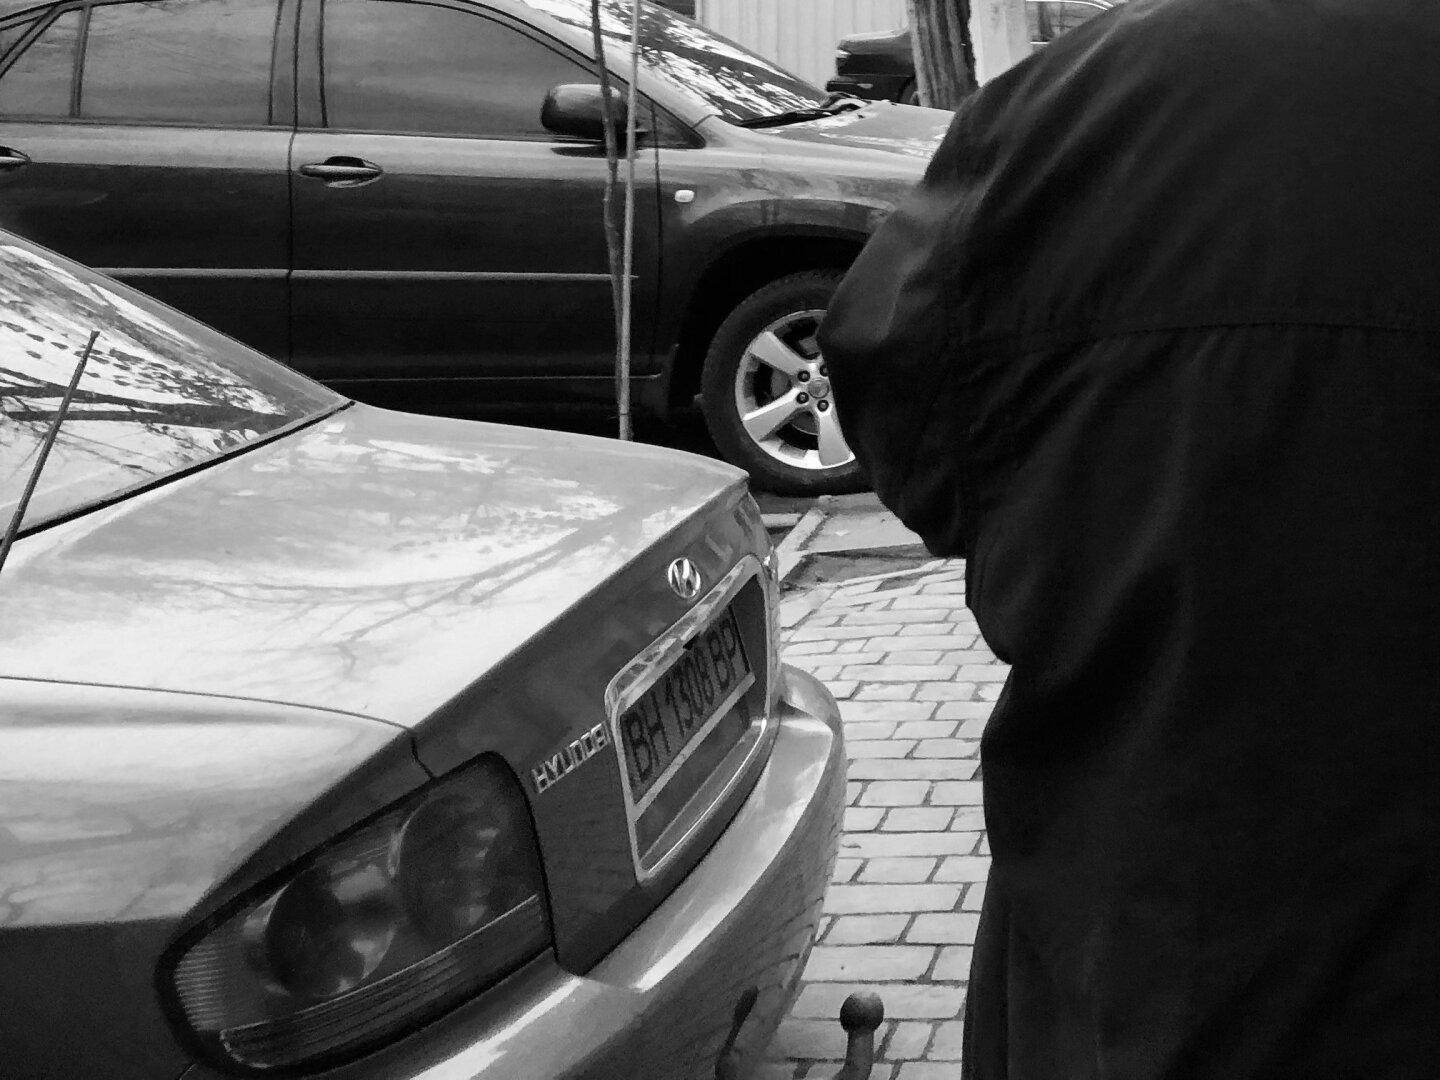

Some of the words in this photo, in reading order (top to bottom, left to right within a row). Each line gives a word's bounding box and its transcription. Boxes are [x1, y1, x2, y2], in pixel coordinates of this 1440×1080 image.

[531, 720, 611, 793] HYUNDAI
[624, 691, 671, 783] BH
[707, 616, 737, 691] BP
